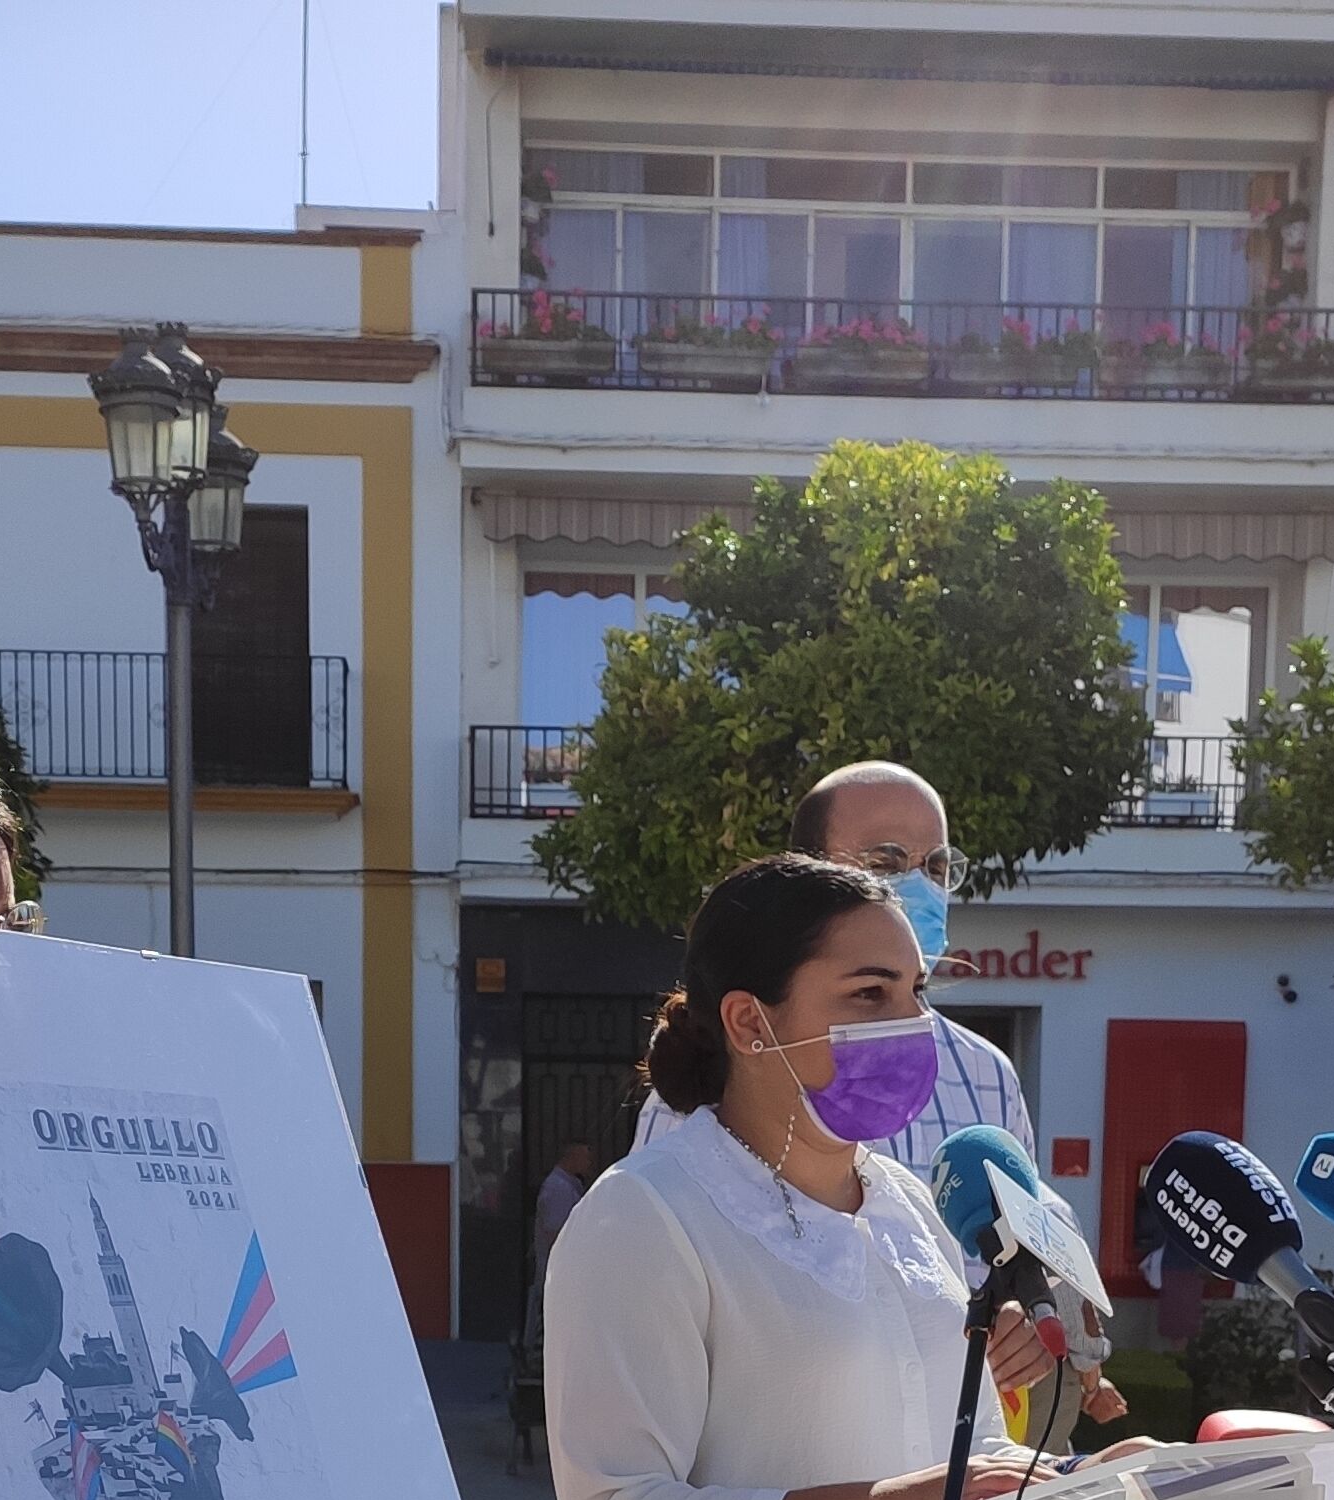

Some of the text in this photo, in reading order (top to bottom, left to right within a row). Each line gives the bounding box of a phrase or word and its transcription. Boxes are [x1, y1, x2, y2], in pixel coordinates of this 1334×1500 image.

[933, 930, 1092, 979] ander
[32, 1108, 219, 1154] ORGULLO
[136, 1161, 232, 1184] LEBRIJA
[1214, 1142, 1285, 1223] Lebrija
[1315, 1157, 1333, 1174] TV
[185, 1189, 236, 1210] 2021
[938, 1172, 964, 1219] OPE
[1165, 1169, 1248, 1248] Digital
[1156, 1189, 1235, 1268] El Cuervo
